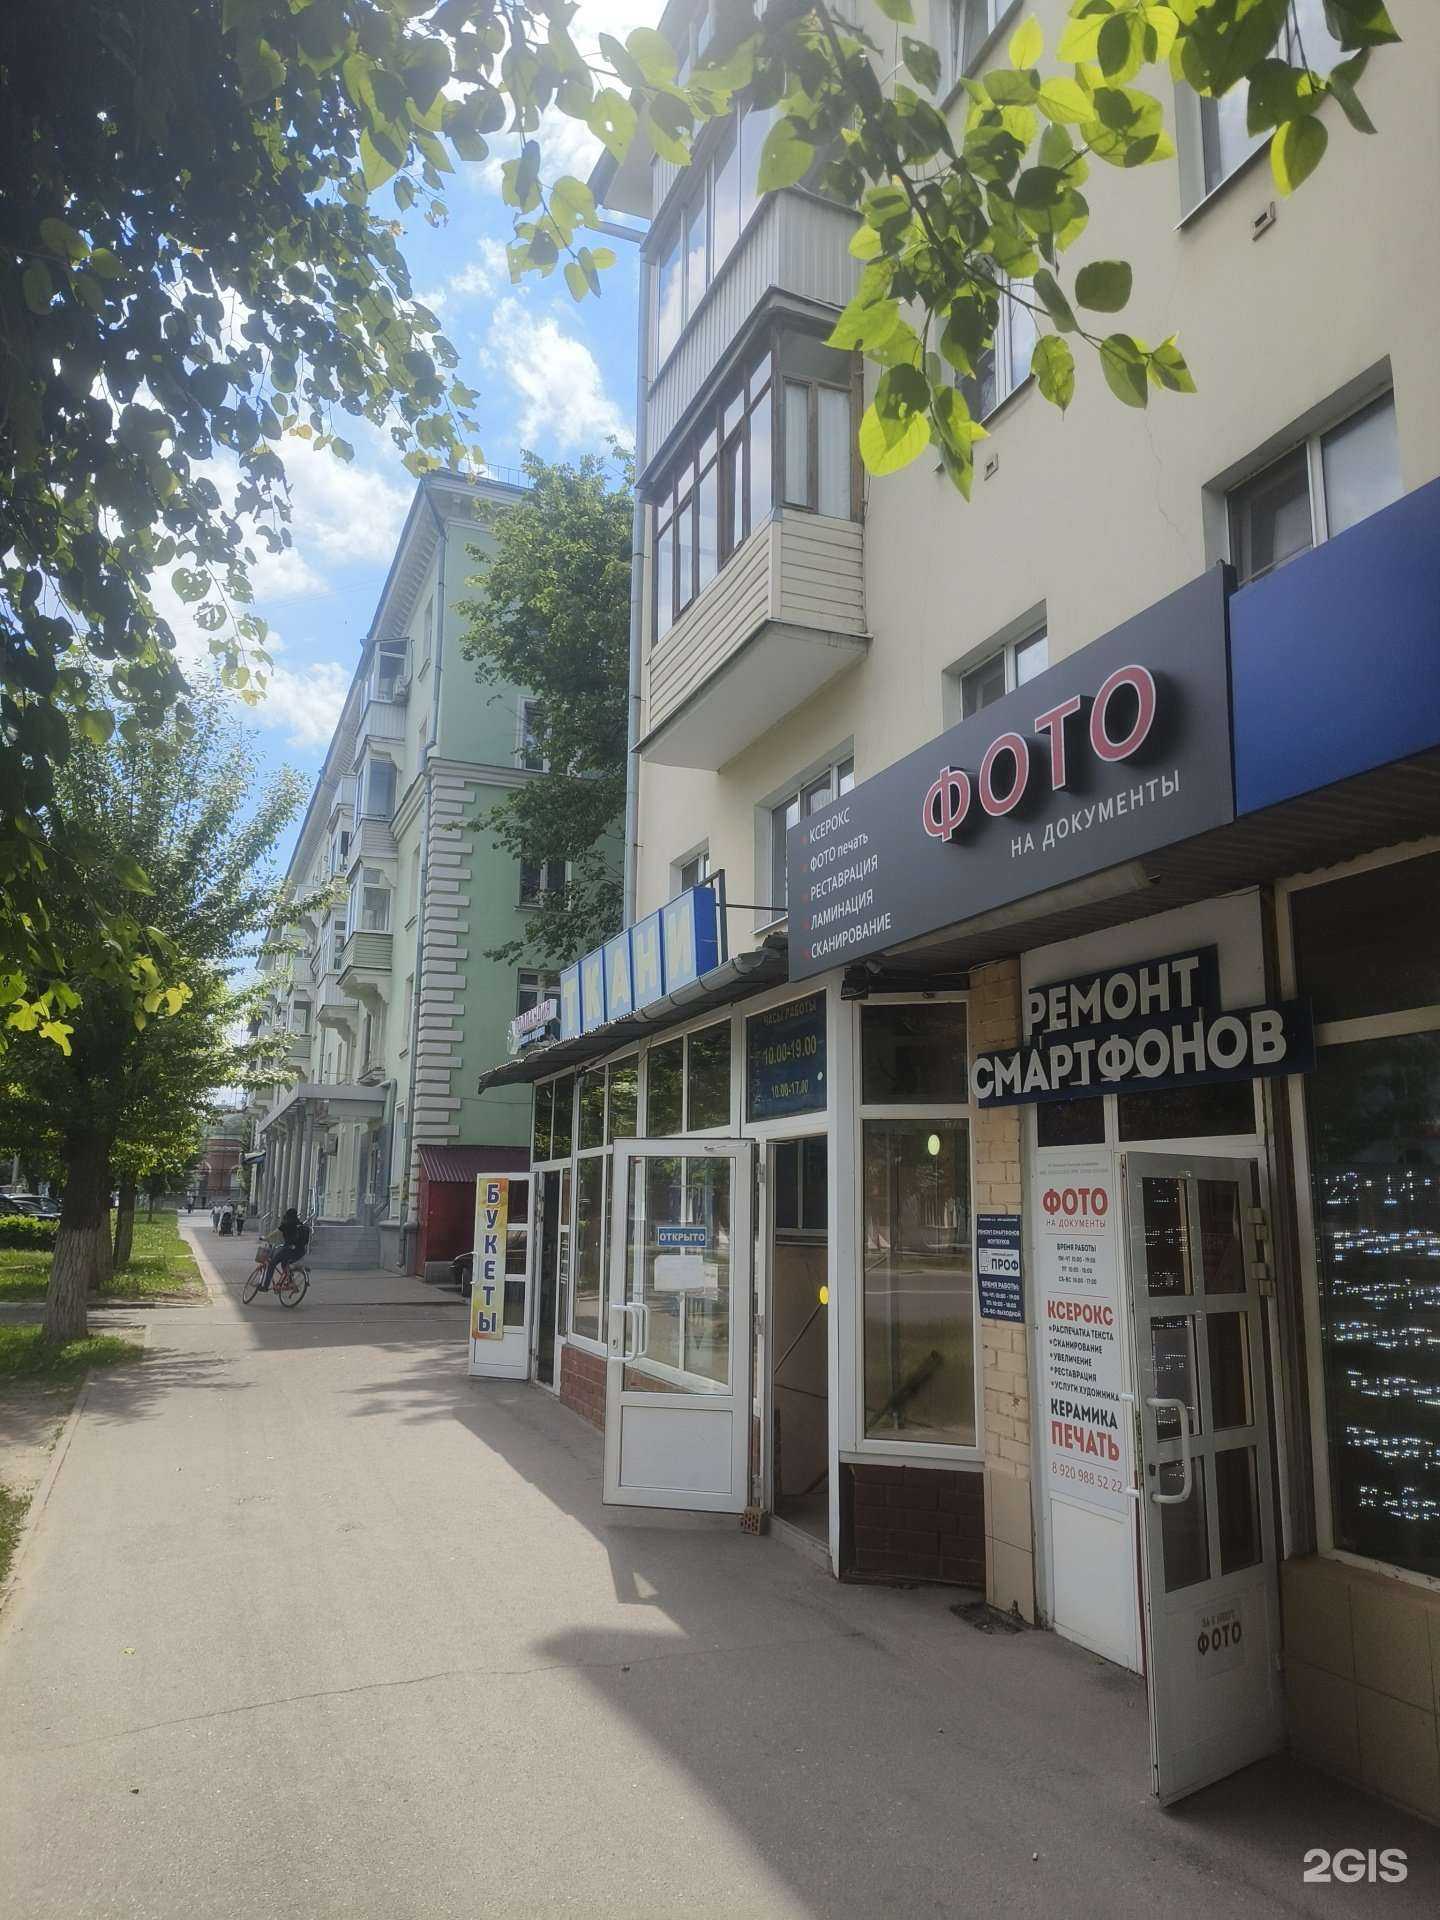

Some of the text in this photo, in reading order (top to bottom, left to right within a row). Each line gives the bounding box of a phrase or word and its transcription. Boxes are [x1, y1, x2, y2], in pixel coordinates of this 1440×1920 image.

[922, 664, 1156, 843] ФОТО
[809, 807, 851, 844] КСЕРОКС
[1010, 770, 1180, 859] НА ДОКУМЕНТЫ
[810, 831, 869, 873] ФОТО печать
[810, 854, 878, 901] РЕСТАВРАЦИЯ
[810, 889, 874, 931] ЛАМИНАЦИЯ
[811, 912, 892, 959] СКАНИРОВАНИЕ
[563, 903, 693, 1033] ТКАНИ
[1023, 956, 1199, 1036] РЕМОНТ
[970, 1009, 1287, 1099] СМАРТФОНОВ
[1043, 1188, 1108, 1216] ФОТО
[659, 1232, 705, 1243] ОТКРЫТО
[1046, 1218, 1106, 1228] НА ДОКУМЕНТЫ
[478, 1183, 500, 1333] БУКЕТЫ
[991, 1258, 1019, 1271] ПРОФ
[1048, 1300, 1113, 1326] КСЕРОКС
[1053, 1325, 1114, 1341] РАСПЕЧАТКА ТЕКСТА
[1053, 1339, 1102, 1354] СКАНИРОВАНИЕ
[1054, 1353, 1092, 1367] УВЕЛИЧЕНИЕ
[1054, 1366, 1097, 1383] РЕСТАВРАЦИЯ
[1054, 1380, 1120, 1401] УСЛУГИ ХУДОЖНИКА
[1051, 1398, 1118, 1430] КЕРАМИКА
[1052, 1421, 1120, 1461] ПЕЧАТЬ
[1052, 1463, 1123, 1494] 8 920 988 52 22
[1197, 1622, 1242, 1656] ФОТО
